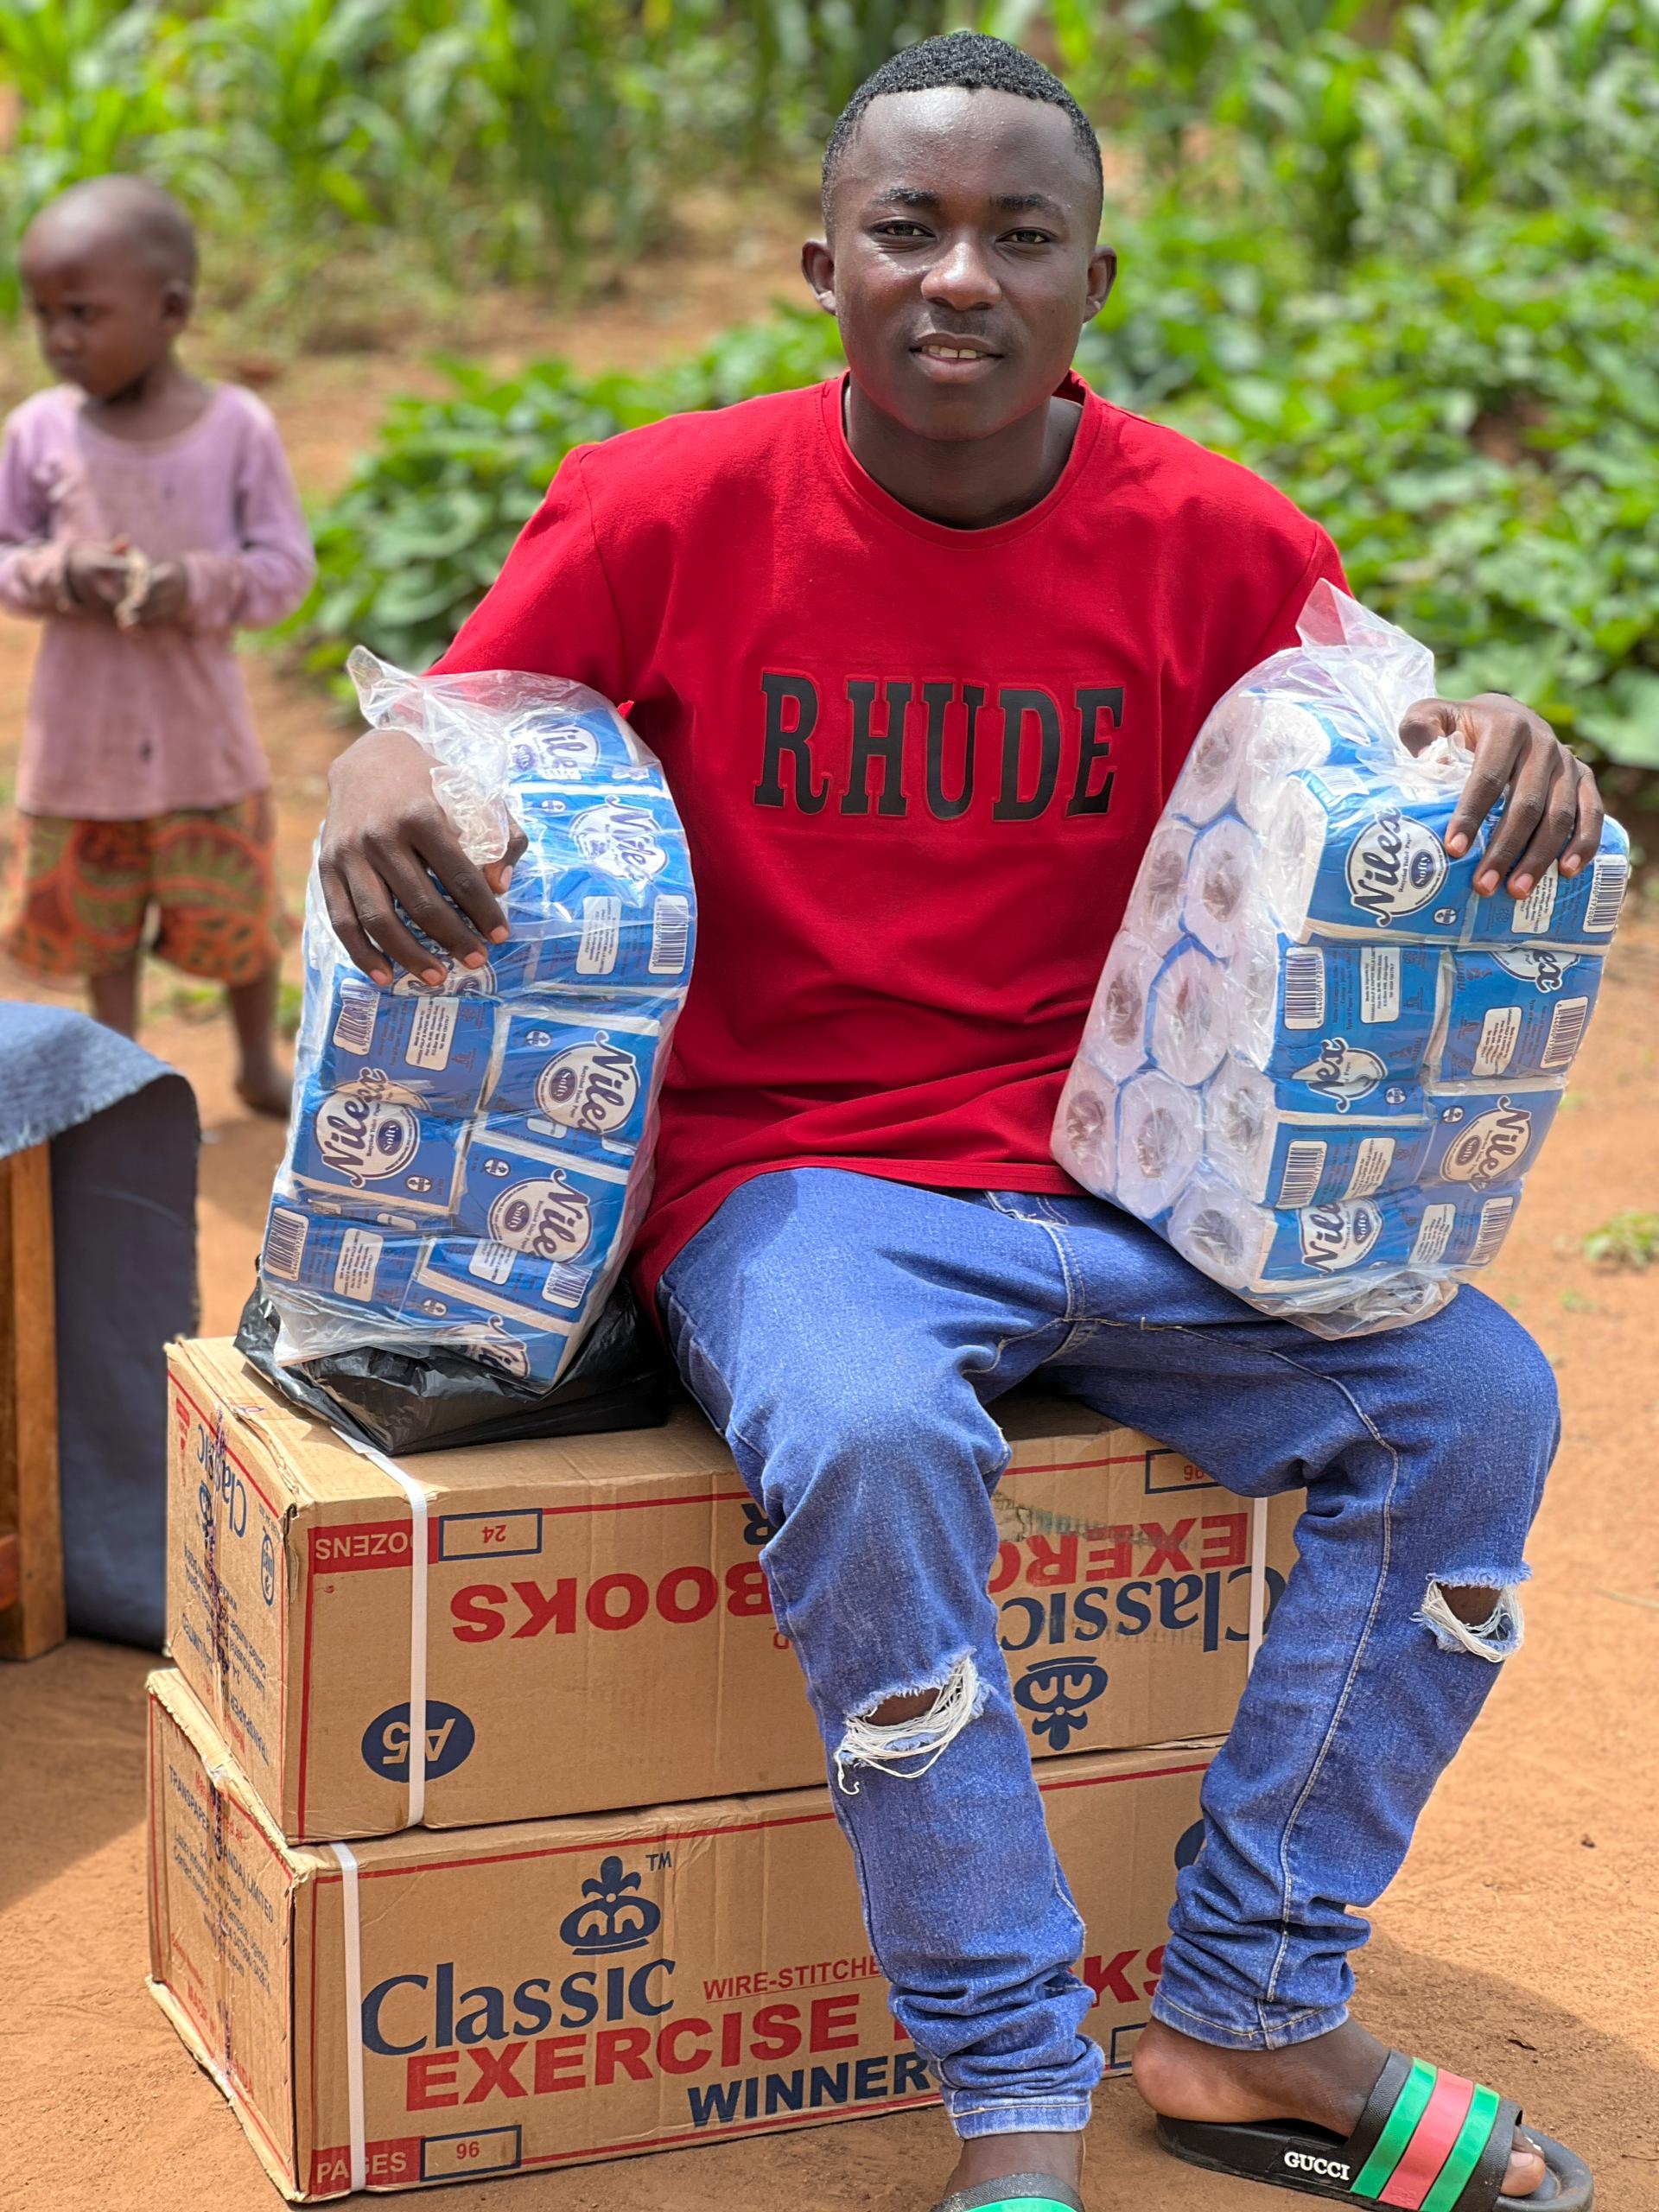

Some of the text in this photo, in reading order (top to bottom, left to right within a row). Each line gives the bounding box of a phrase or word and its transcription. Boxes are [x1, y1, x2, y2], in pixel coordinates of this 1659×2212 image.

[536, 720, 587, 767] Nile
[753, 671, 1124, 822] RHUDE
[1354, 808, 1401, 924] Nilex
[1397, 868, 1408, 892] Recycled
[1414, 854, 1431, 884] Softy
[555, 1070, 569, 1098] Softy
[384, 1124, 398, 1151] Softy
[1357, 1211, 1366, 1241] Softy
[315, 1524, 507, 1561] OZENS 24
[449, 1560, 773, 1643] BOOKS
[1000, 1566, 1287, 1652] Classic
[382, 1718, 456, 1764] A5
[645, 1850, 673, 1872] TM
[702, 1955, 880, 2001] WIRE-STITCHE
[360, 1957, 676, 2056] Classic
[406, 1993, 860, 2112] EXERCISE
[455, 2141, 480, 2160] 96
[1284, 2152, 1351, 2181] GUCCI
